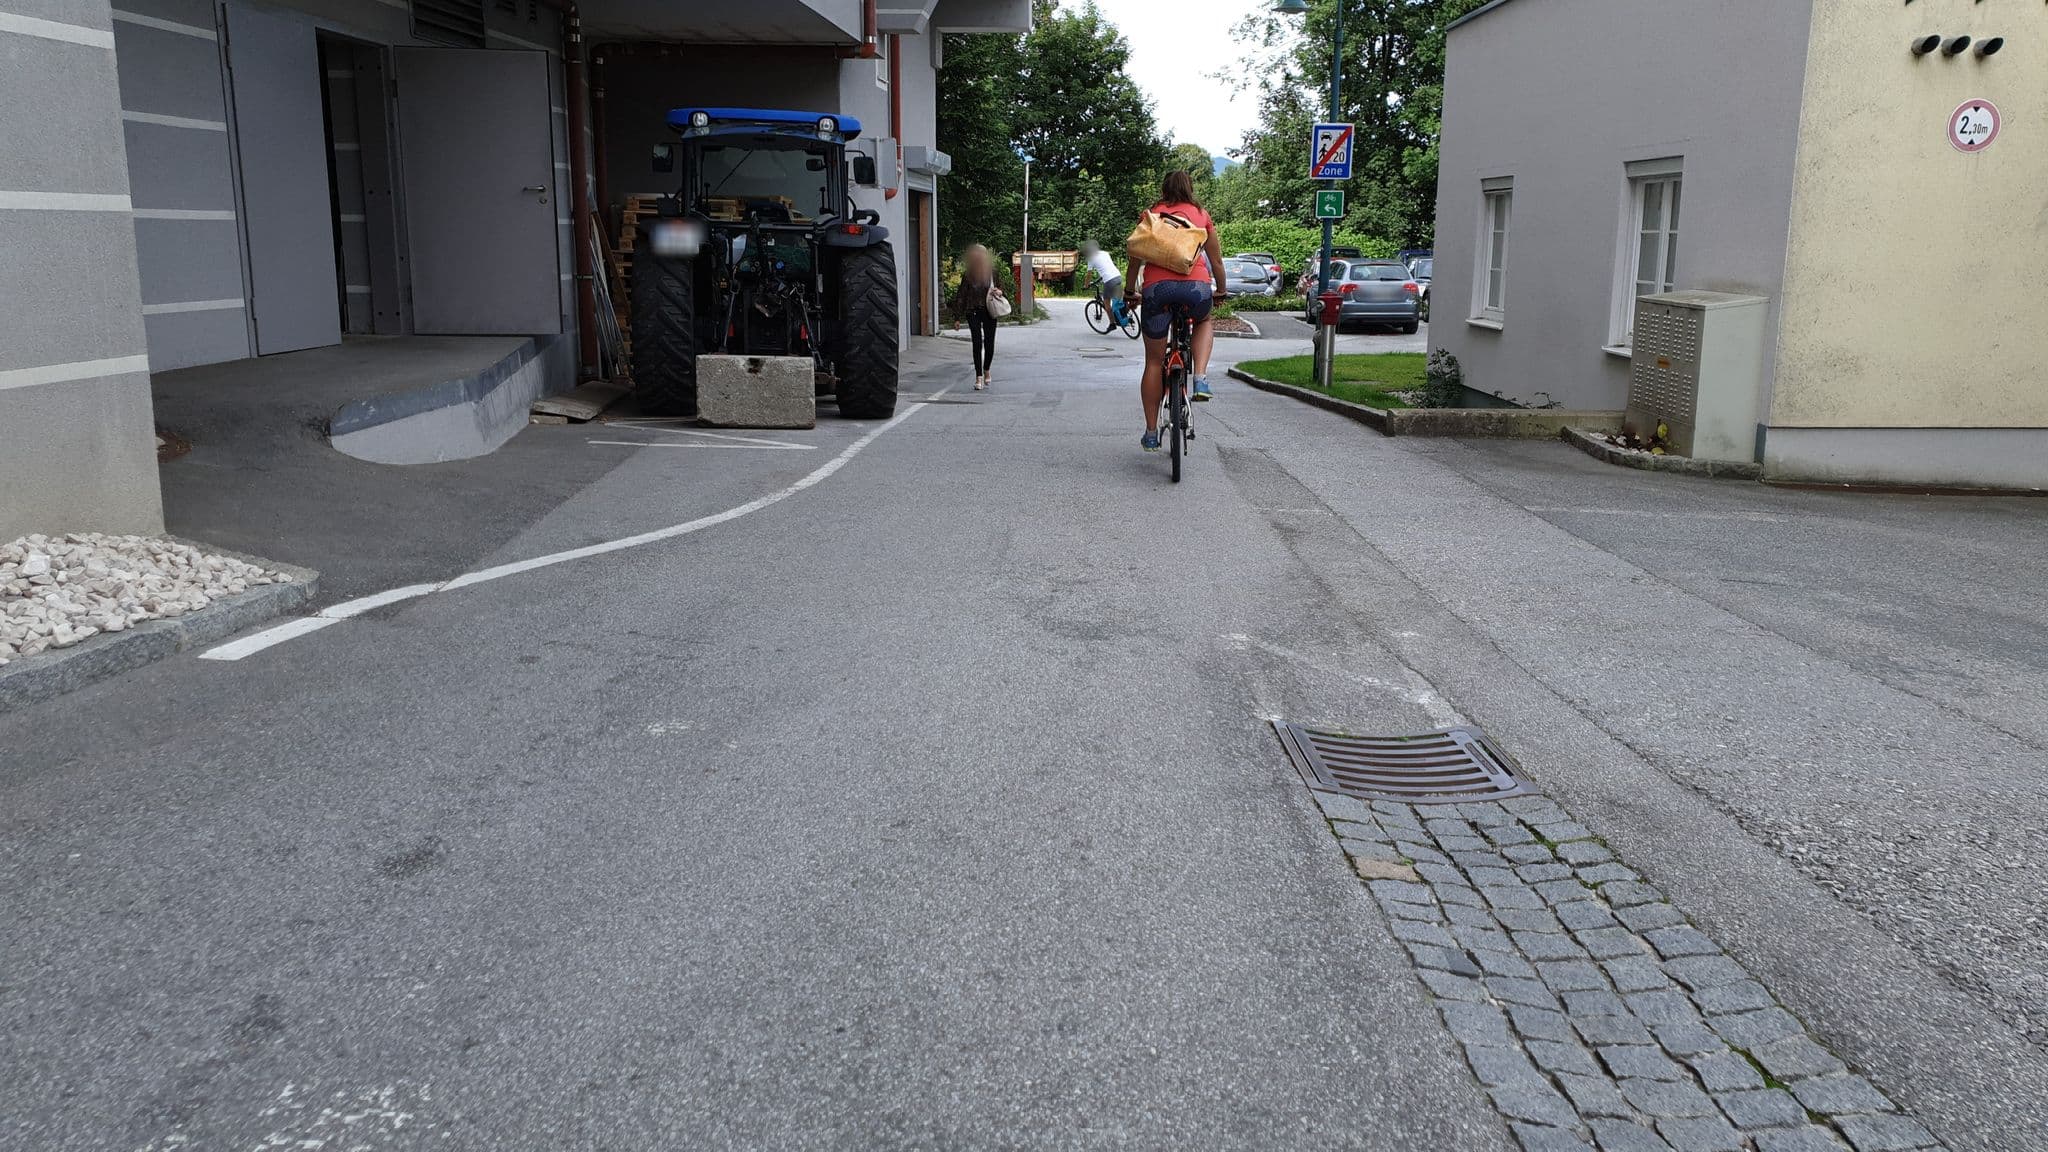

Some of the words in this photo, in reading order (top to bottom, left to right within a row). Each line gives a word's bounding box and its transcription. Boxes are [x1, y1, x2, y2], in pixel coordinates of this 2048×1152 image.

[1960, 115, 1988, 135] 2,30m
[1333, 151, 1345, 163] 20
[1318, 166, 1343, 176] Zone
